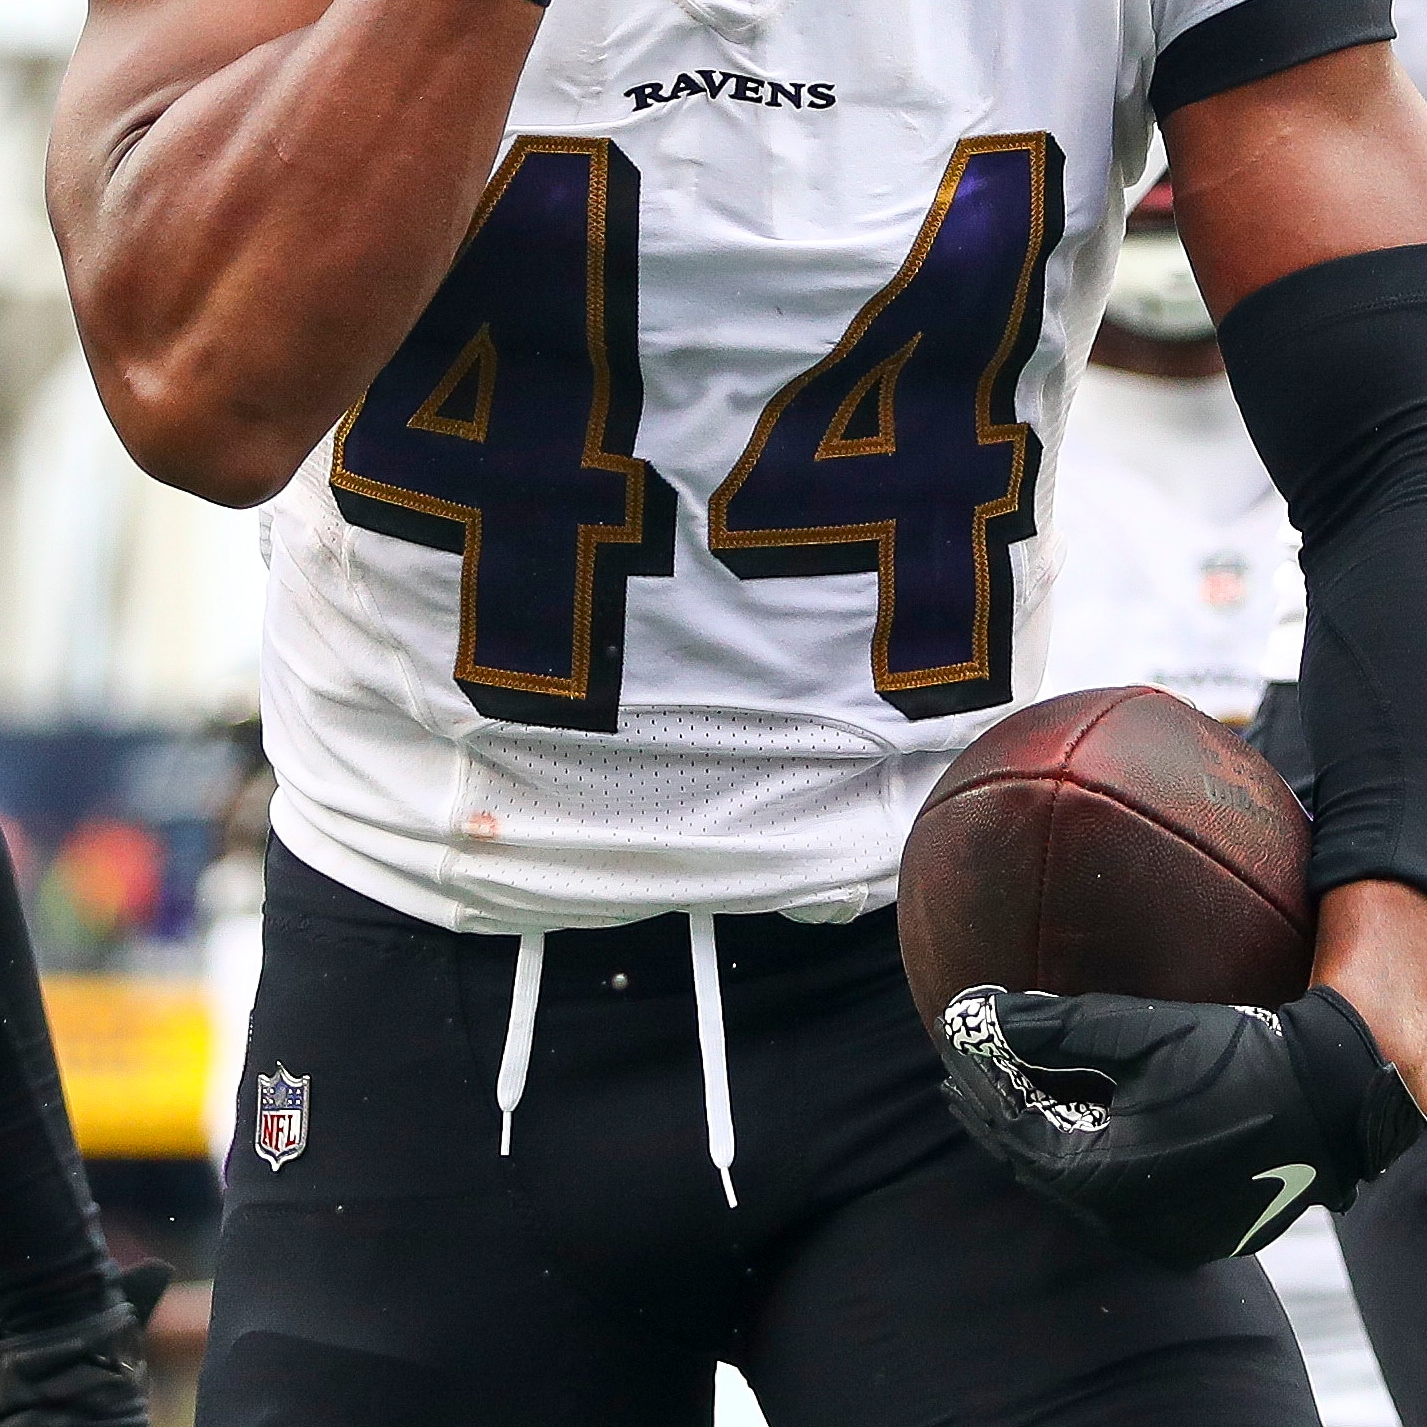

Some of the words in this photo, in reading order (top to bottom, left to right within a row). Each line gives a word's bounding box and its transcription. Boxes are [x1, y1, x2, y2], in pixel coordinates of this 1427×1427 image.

[624, 69, 836, 112] RAVENS
[329, 132, 1067, 733] 44
[262, 1114, 297, 1153] NFL
